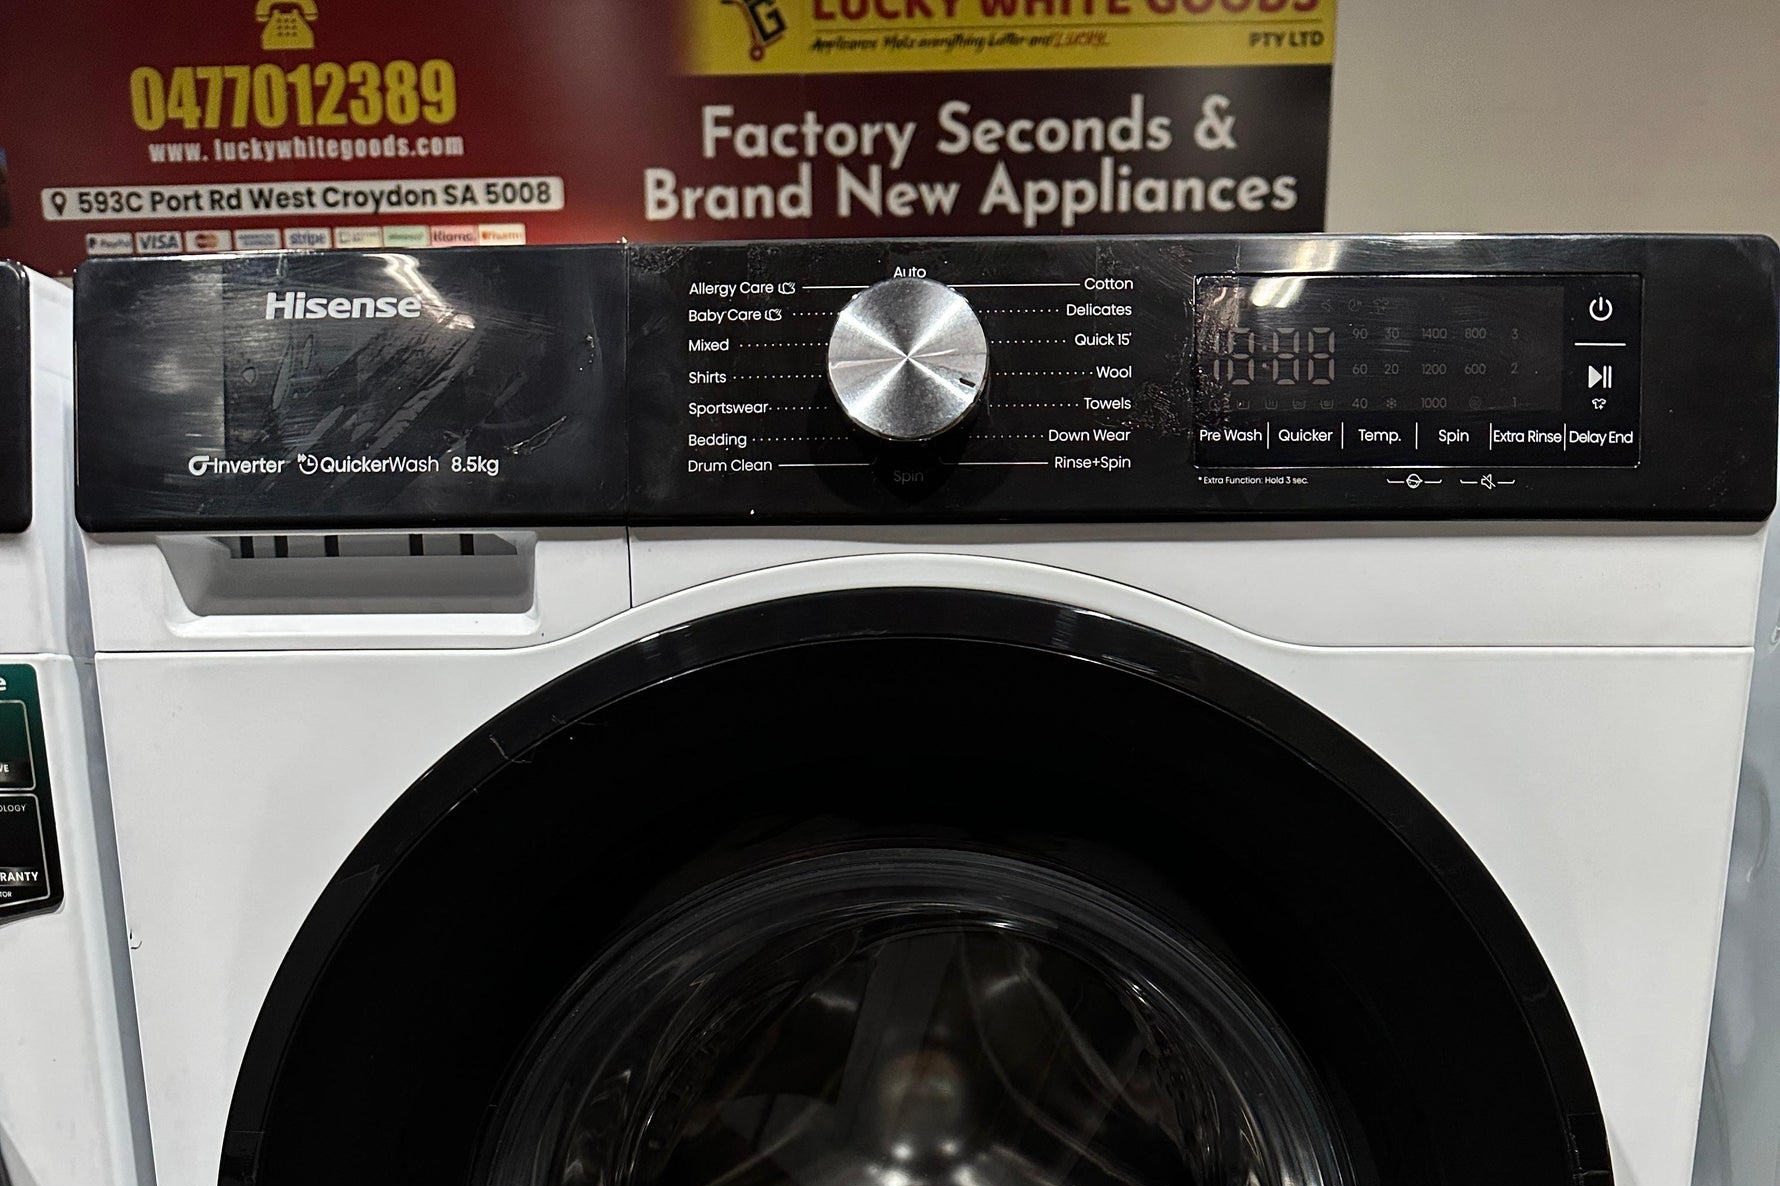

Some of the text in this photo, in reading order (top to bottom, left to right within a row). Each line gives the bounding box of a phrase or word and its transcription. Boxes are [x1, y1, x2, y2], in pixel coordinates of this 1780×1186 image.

[1249, 30, 1325, 48] PTY LTD
[130, 59, 457, 131] 0477012389
[701, 94, 1237, 169] Factory Seconds &
[78, 182, 552, 213] 593C Port Rd West Croydon SA 5008
[644, 158, 1299, 229] Brand New Appliances
[139, 234, 178, 249] VISA
[893, 265, 927, 279] Auto
[689, 280, 775, 298] Allergy Care
[1084, 277, 1134, 292] Cotton
[265, 291, 422, 320] Hisense
[1066, 303, 1133, 318] Delicates
[688, 307, 762, 325] Baby Care
[1074, 333, 1117, 348] Quick
[1352, 328, 1519, 340] 90 30 1400 800 3
[688, 338, 730, 353] Mixed
[1096, 365, 1133, 380] Wool
[1352, 363, 1519, 376] 60 20 1200 600 2
[688, 370, 727, 385] Shirts
[688, 401, 769, 418] Sportswear
[1084, 396, 1132, 411] Towels
[1351, 397, 1368, 410] 40
[1421, 397, 1448, 410] 1000
[688, 432, 748, 450] Bedding
[1048, 428, 1131, 443] Down Wear
[1200, 428, 1263, 442] Pre Wash
[1278, 428, 1333, 442] Quicker
[1358, 429, 1402, 445] Temp.
[1438, 429, 1470, 446] Spin
[1493, 430, 1562, 443] Extra Rinse
[1569, 430, 1634, 447] Delay End
[213, 455, 500, 477] Inverter QuickerWash 8.5kg
[687, 458, 773, 473] Drum Clean
[1054, 455, 1132, 473] Rinse+Spin
[893, 469, 924, 485] Spin
[1204, 476, 1309, 485] Extra Function: Hold 3 sec.
